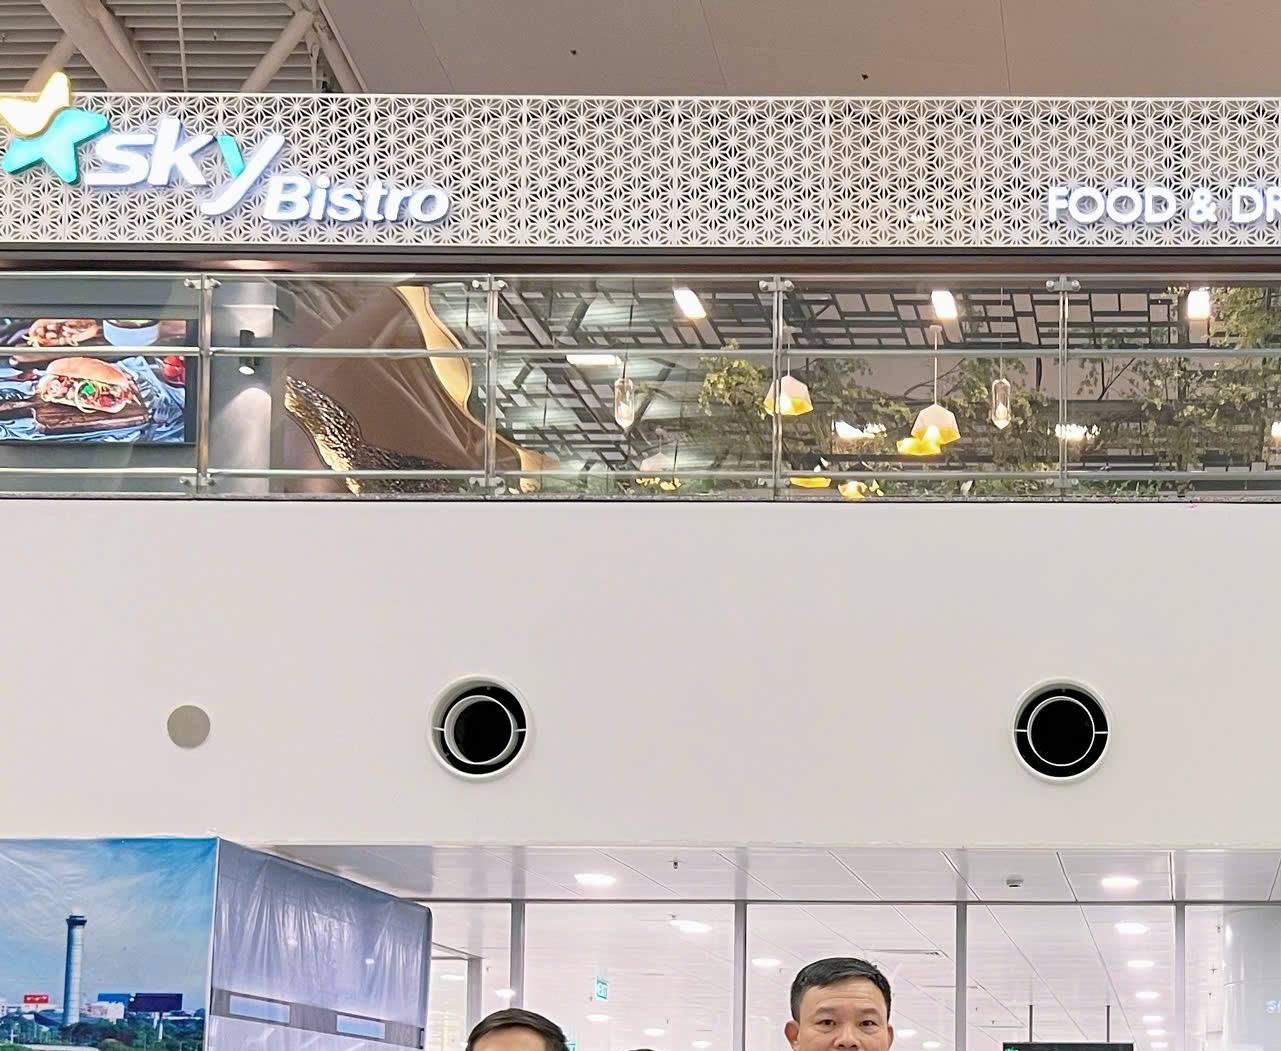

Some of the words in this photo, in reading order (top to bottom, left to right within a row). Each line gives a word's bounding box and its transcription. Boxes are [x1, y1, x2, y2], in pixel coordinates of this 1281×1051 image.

[85, 114, 287, 217] sky
[263, 175, 450, 222] Bistro
[1048, 186, 1177, 223] FOOD
[1189, 186, 1218, 223] &
